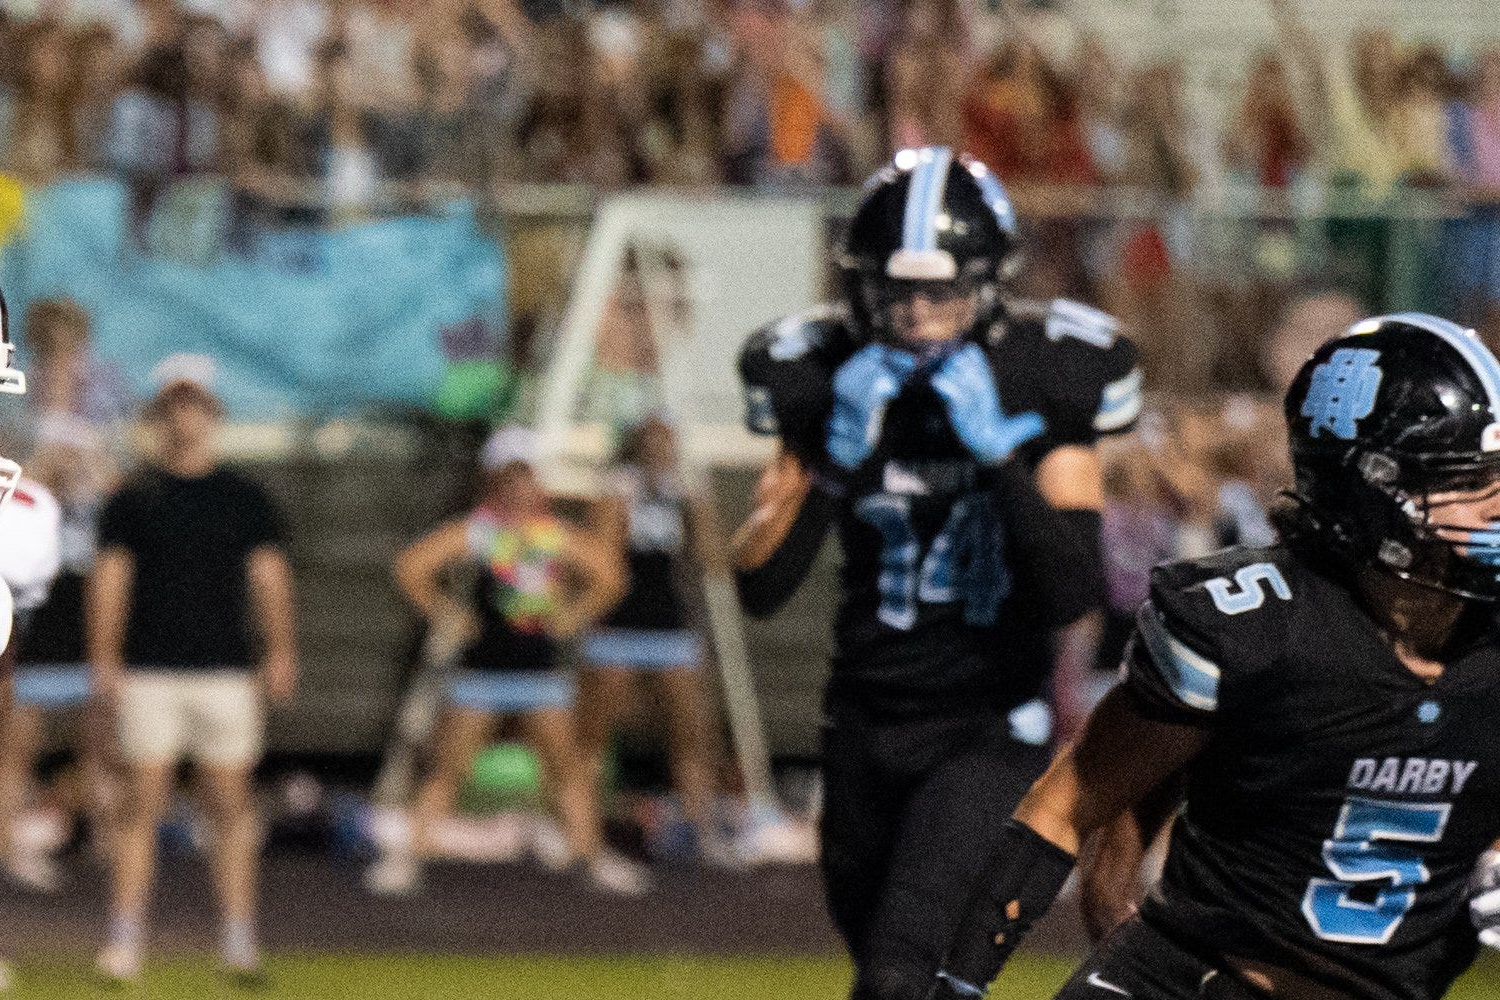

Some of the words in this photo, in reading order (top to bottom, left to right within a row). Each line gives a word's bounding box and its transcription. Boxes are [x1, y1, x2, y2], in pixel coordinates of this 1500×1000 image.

[1204, 562, 1293, 615] 5
[1349, 757, 1479, 795] DARBY
[1302, 796, 1453, 945] 5
